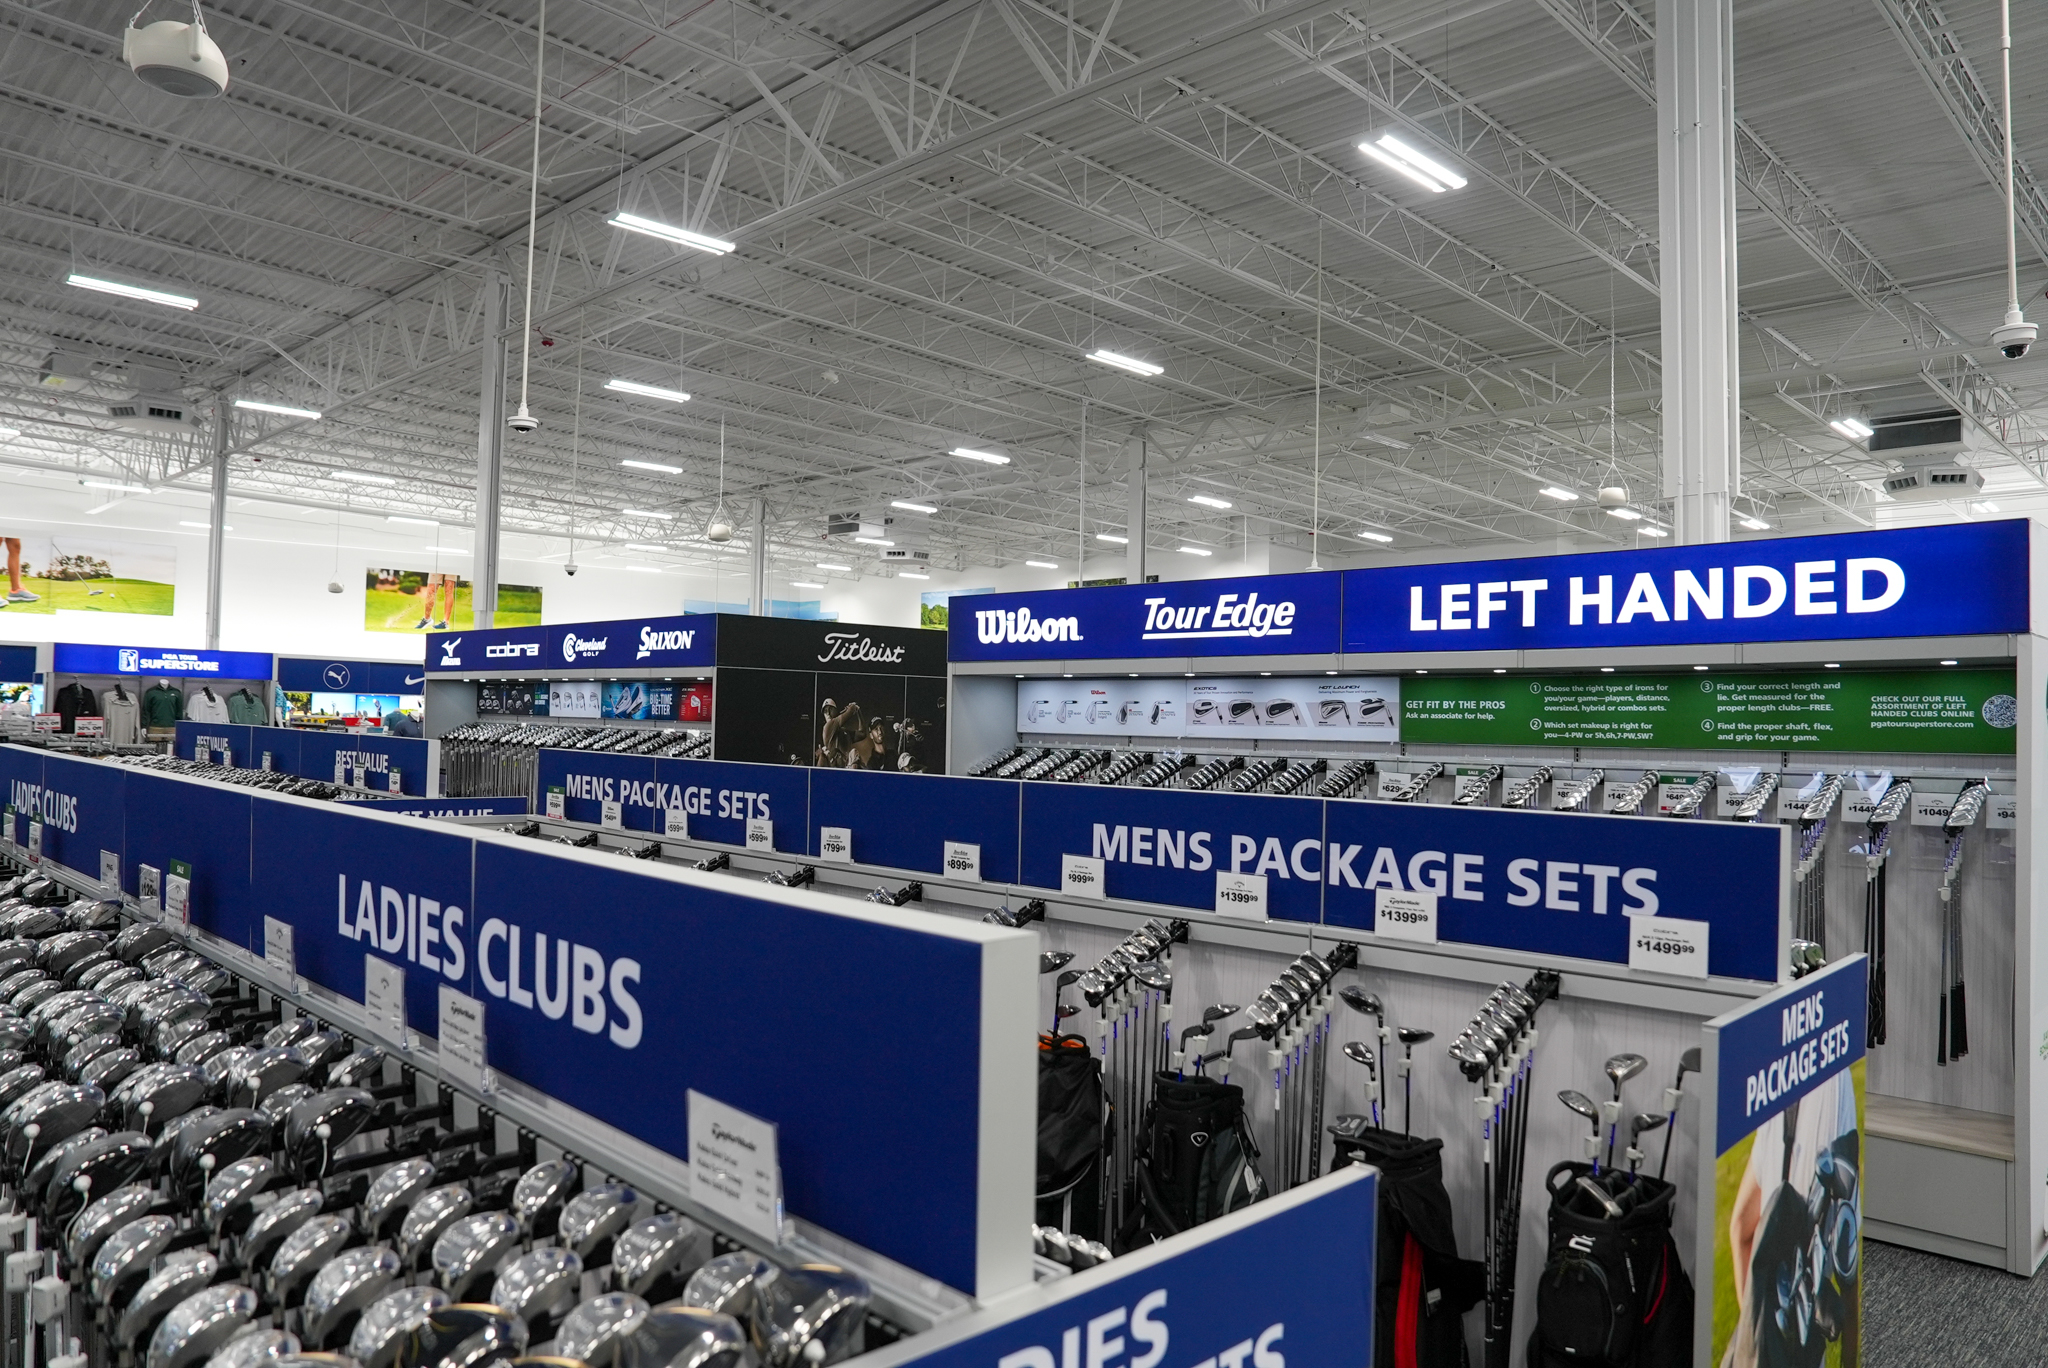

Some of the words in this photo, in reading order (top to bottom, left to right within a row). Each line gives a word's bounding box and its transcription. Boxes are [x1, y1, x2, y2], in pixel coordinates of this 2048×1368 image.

[1410, 579, 1548, 631] LEFT
[1569, 557, 1906, 626] HANDED
[1143, 597, 1213, 631] Tour
[1212, 592, 1296, 638] Edge
[486, 641, 540, 658] cobra
[575, 636, 608, 651] Cleveland
[636, 626, 695, 660] SRIXON
[818, 632, 905, 663] Titleist
[140, 658, 219, 671] SUPERSTORE
[650, 693, 672, 705] BIG-TIME
[1792, 683, 1820, 691] length
[652, 704, 670, 715] BETTER
[1406, 700, 1424, 709] GET
[1426, 700, 1440, 709] FIT
[1443, 700, 1455, 709] BY
[1458, 700, 1476, 709] THE
[1480, 701, 1506, 709] PROS
[1748, 704, 1776, 712] length
[1813, 723, 1833, 731] flex,
[210, 737, 228, 752] VALUE
[336, 750, 357, 769] BEST
[359, 751, 388, 774] VALUE
[12, 779, 41, 817] LADIES
[44, 789, 78, 834] CLUBS
[566, 774, 614, 802] MENS
[620, 779, 712, 816] PACKAGE
[718, 789, 770, 820] SETS
[1092, 823, 1213, 871] MENS
[1231, 834, 1484, 901] PACKAGE
[1507, 858, 1660, 917] SETS
[338, 873, 466, 982] LADIES
[478, 918, 644, 1050] CLUBS
[1782, 991, 1824, 1046] MENS
[1746, 1038, 1818, 1118] PACKAGE
[1820, 1019, 1849, 1069] SETS
